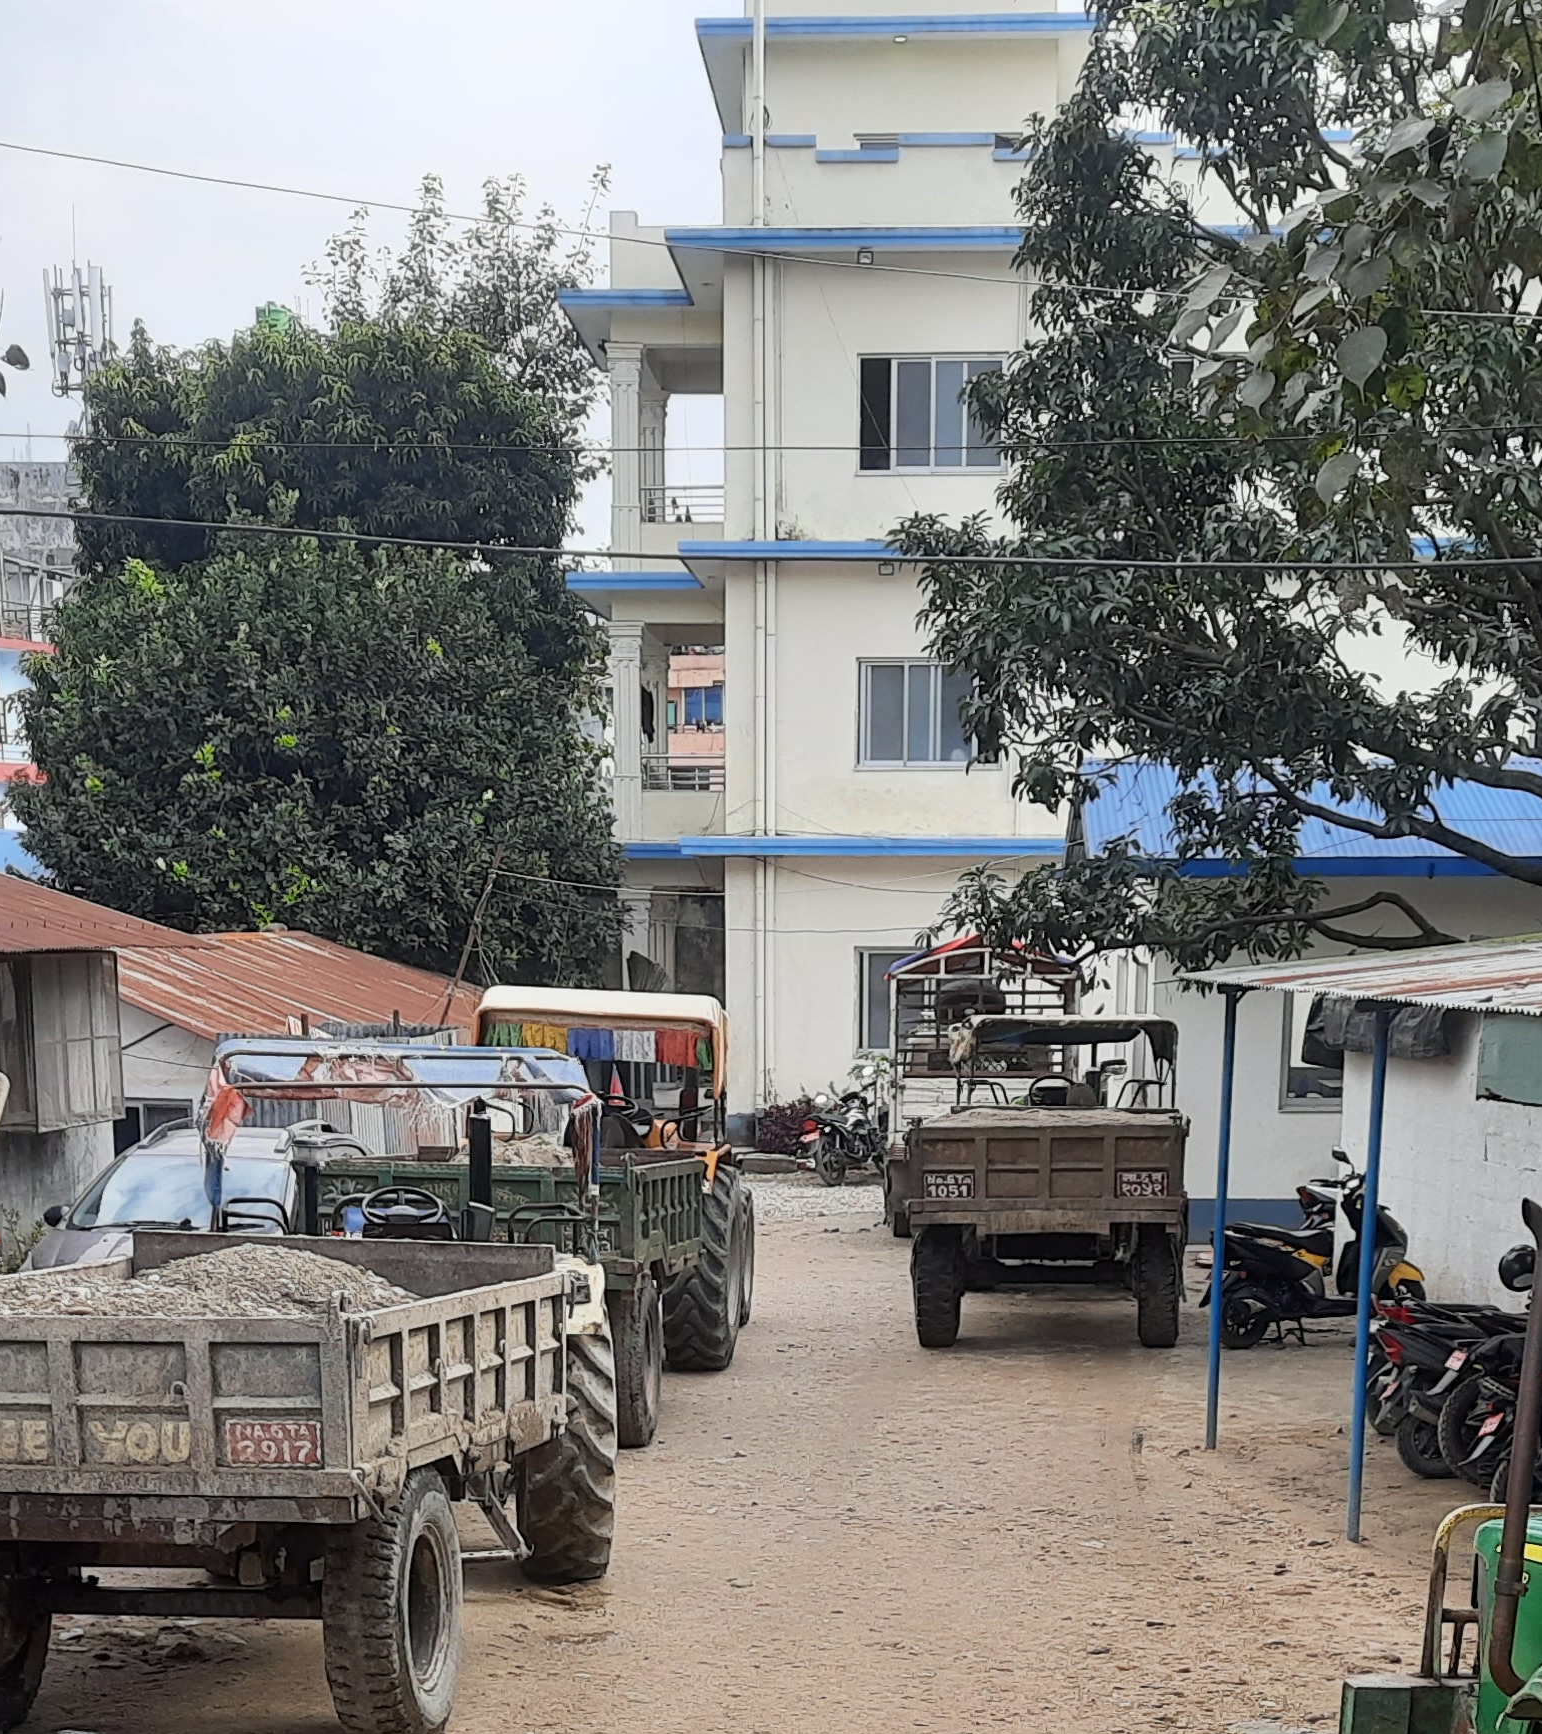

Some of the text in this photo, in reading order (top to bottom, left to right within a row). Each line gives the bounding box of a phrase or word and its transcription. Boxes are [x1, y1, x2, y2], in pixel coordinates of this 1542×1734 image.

[927, 1185, 968, 1198] 1051
[87, 1420, 191, 1463] YOU
[237, 1440, 313, 1463] 2917
